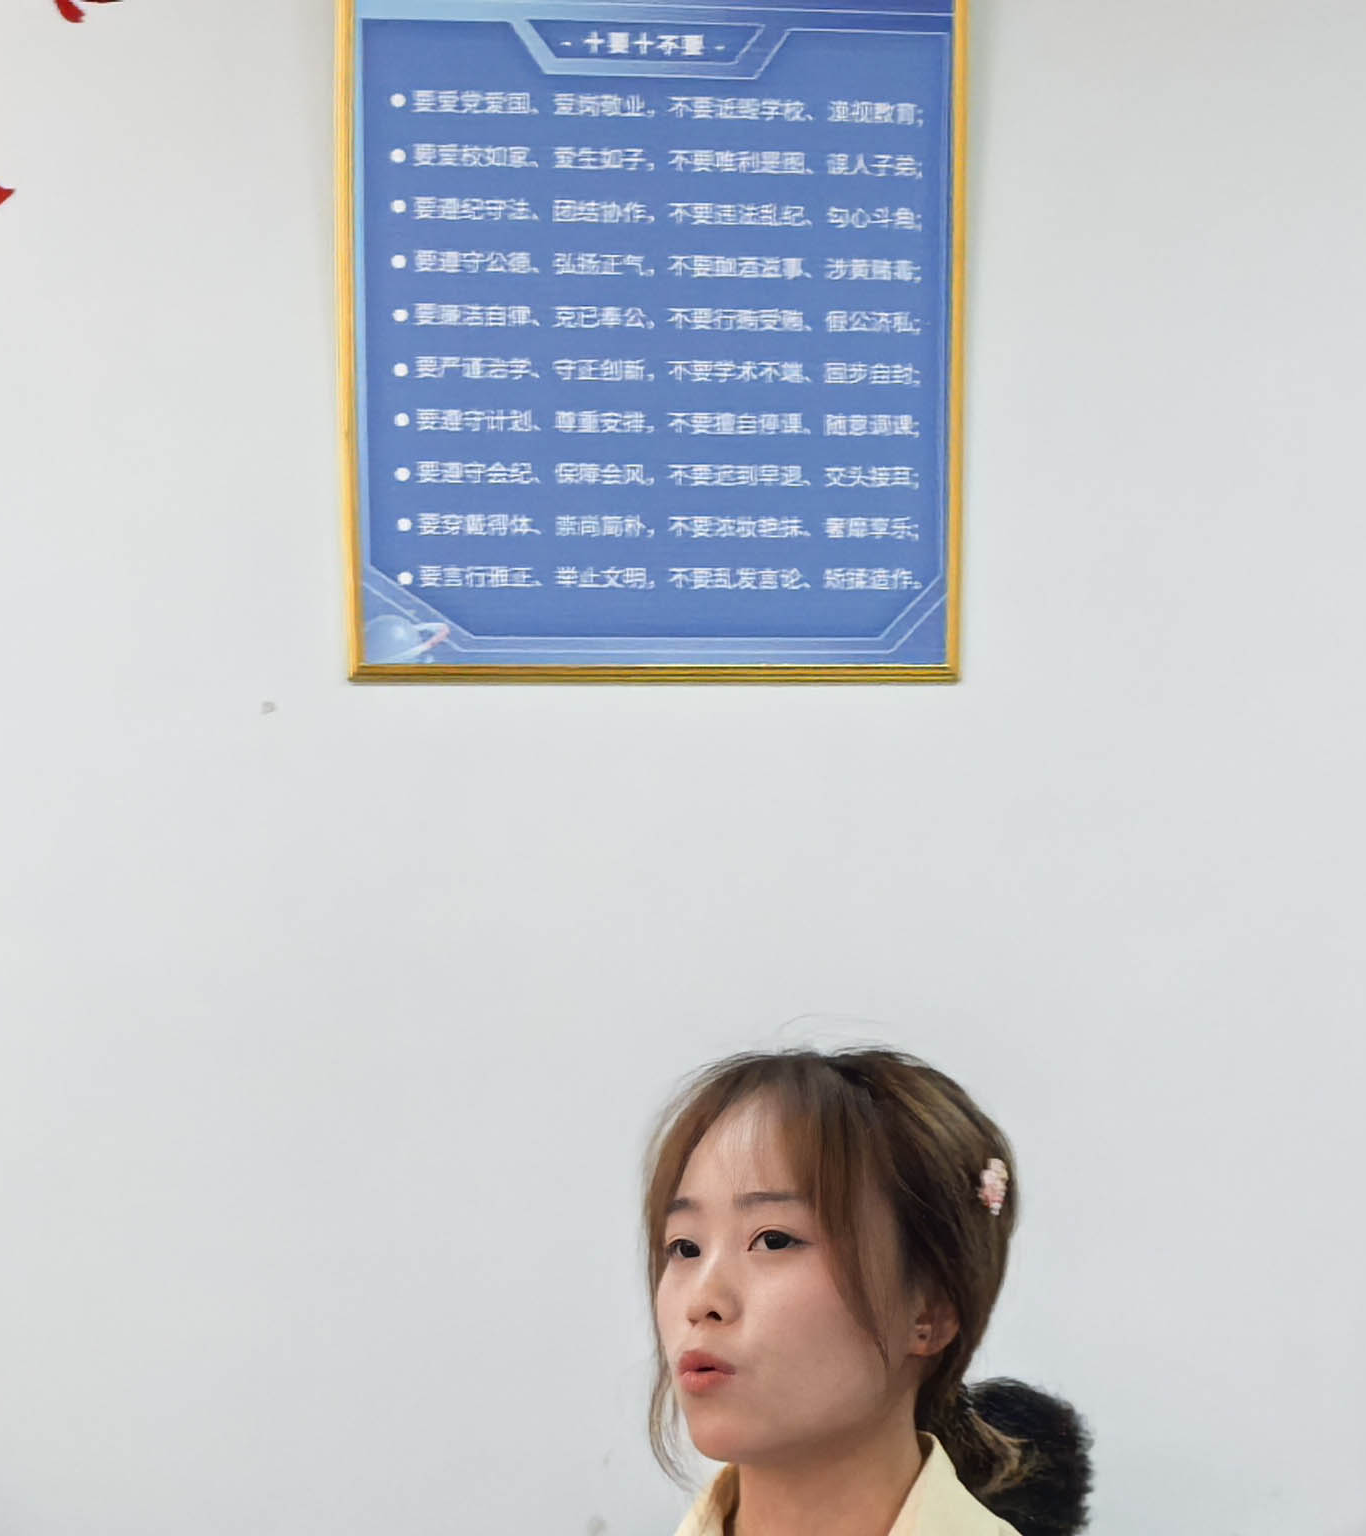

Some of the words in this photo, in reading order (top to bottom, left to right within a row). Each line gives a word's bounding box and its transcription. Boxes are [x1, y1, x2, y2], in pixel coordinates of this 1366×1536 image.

[583, 32, 704, 57] 十要十不要
